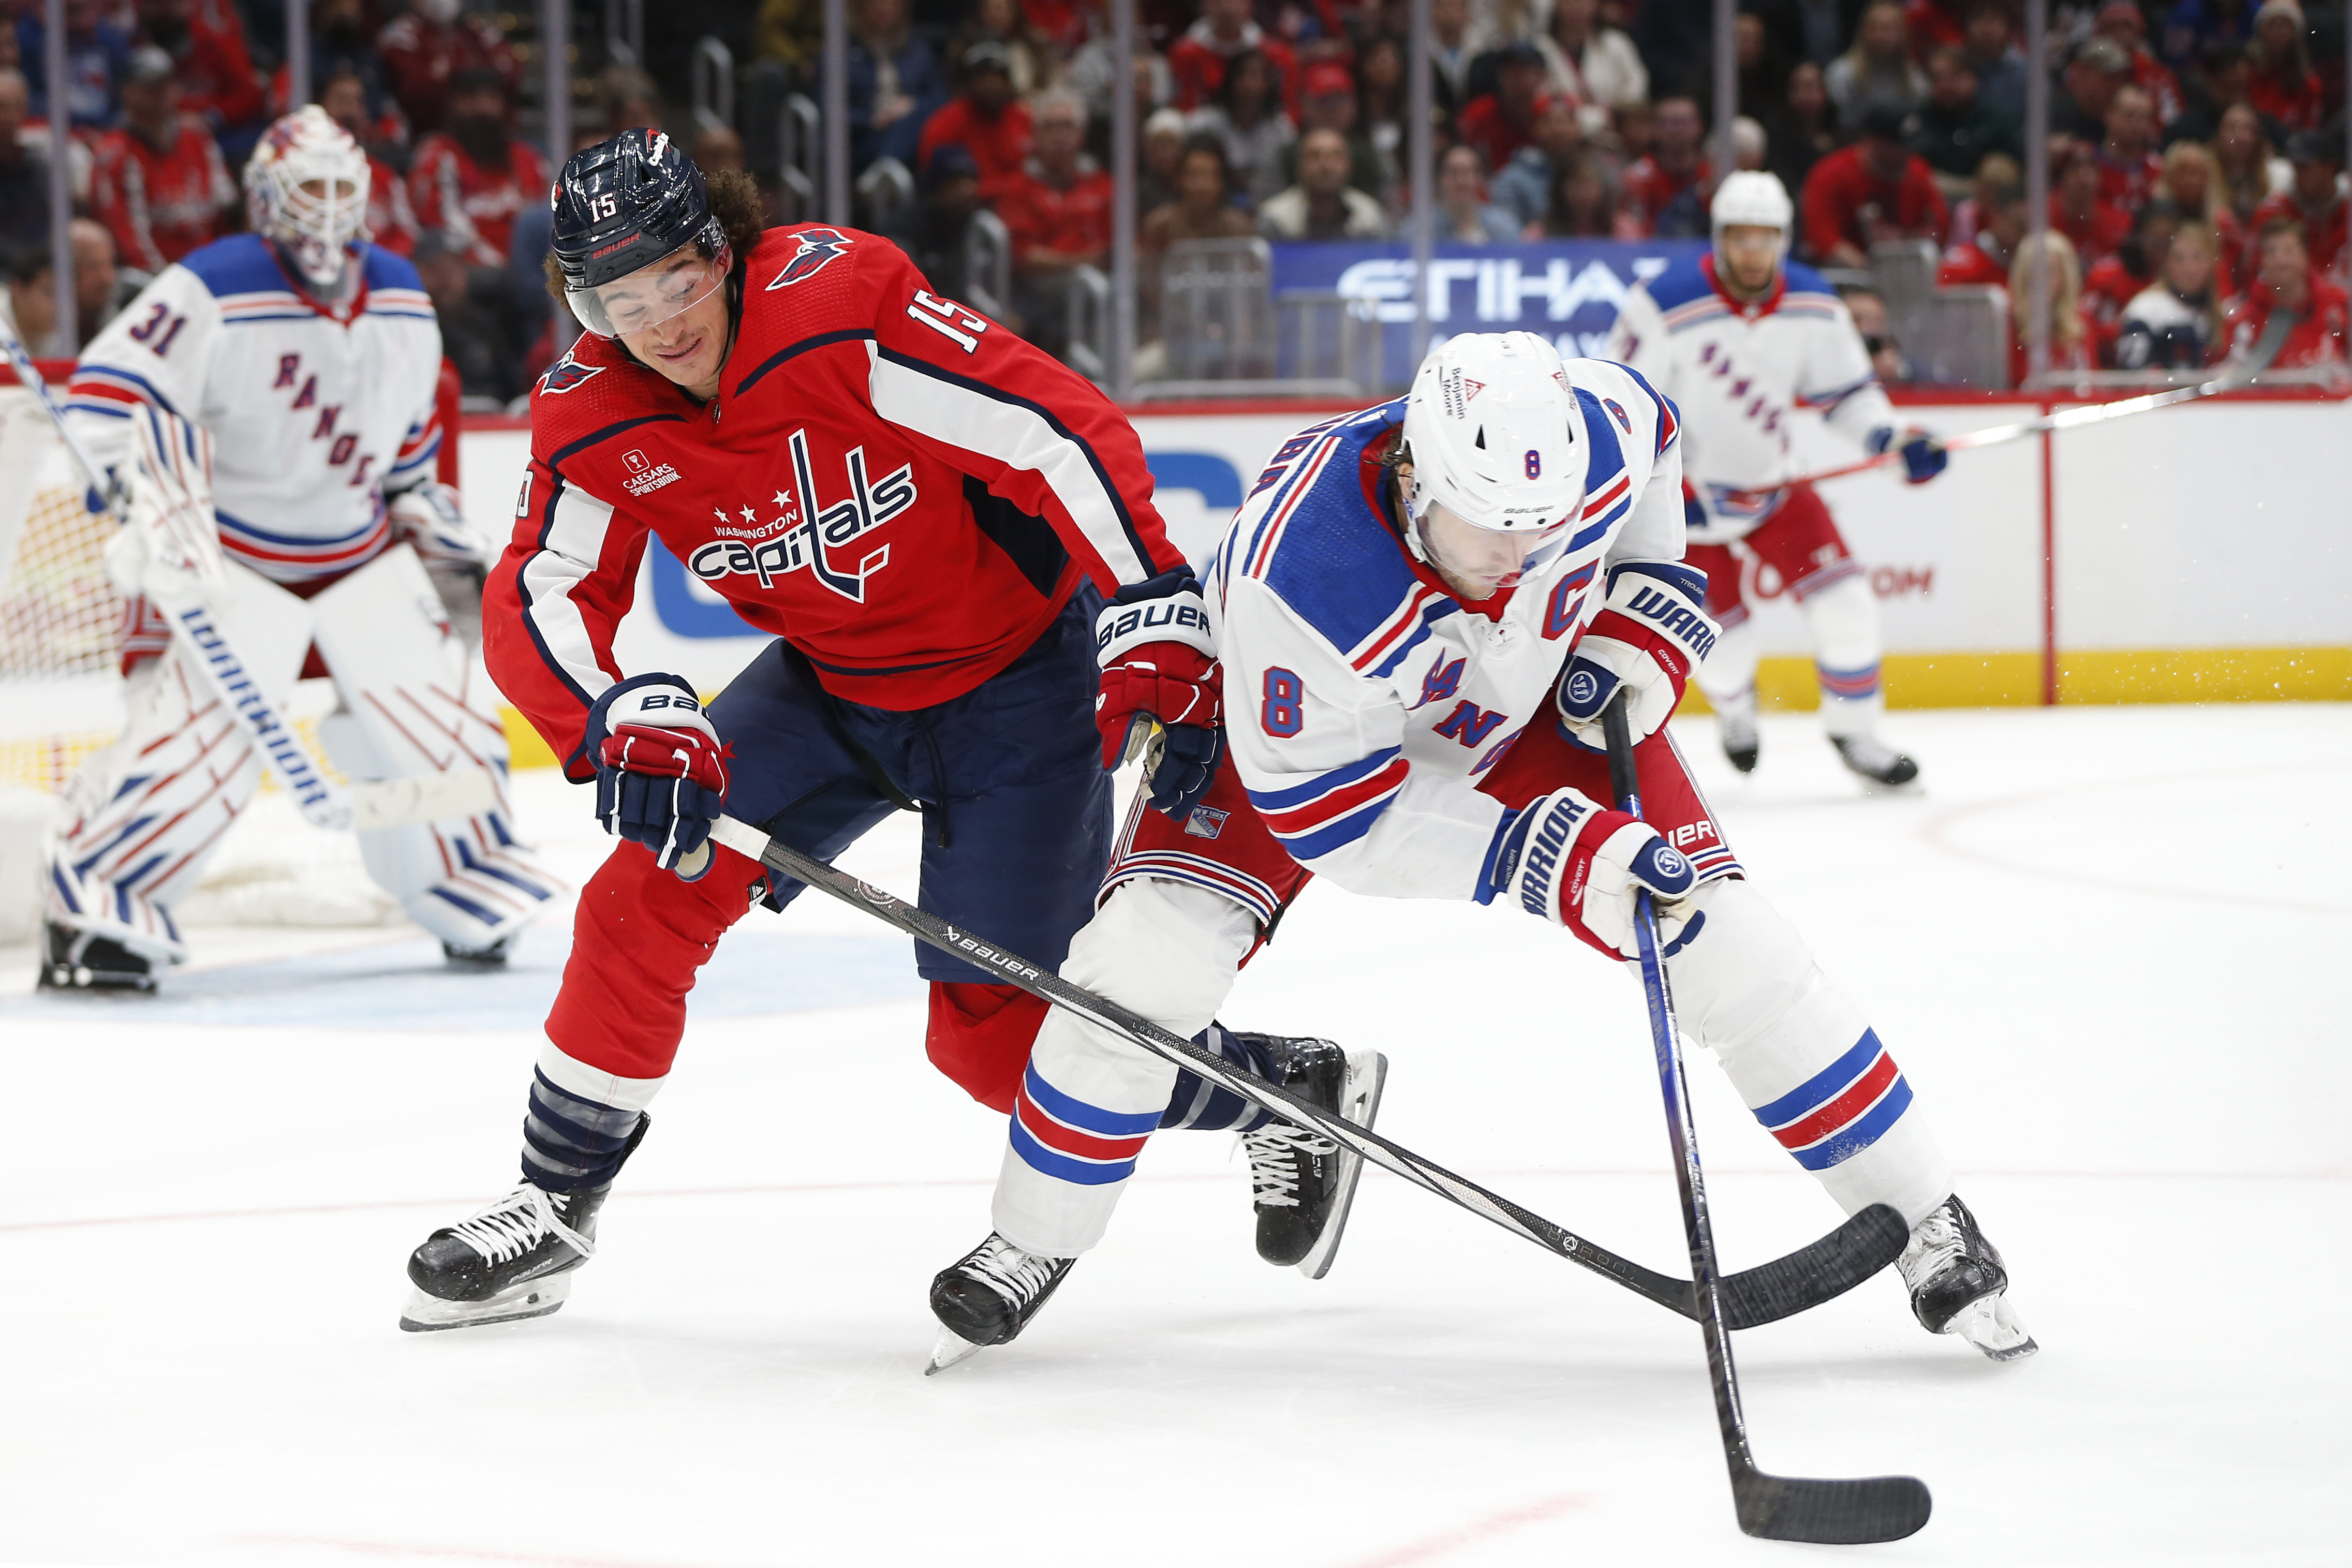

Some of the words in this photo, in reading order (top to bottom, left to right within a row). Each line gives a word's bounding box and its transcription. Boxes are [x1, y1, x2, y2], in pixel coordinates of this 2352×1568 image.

[589, 191, 618, 224] 15
[593, 232, 641, 260] BAUER
[130, 301, 188, 358] 31
[906, 288, 988, 355] 15
[1441, 379, 1455, 417] Moore
[1451, 367, 1467, 420] Benjamin
[629, 470, 682, 497] SPORTSBOOK
[1525, 450, 1540, 480] 8
[714, 509, 798, 539] WASHINGTON
[1503, 505, 1555, 514] BAUER
[1541, 557, 1600, 641] C
[1098, 604, 1211, 650] BAUER
[1657, 648, 1680, 675] COVERT
[179, 608, 329, 806] WARRIOR
[1261, 665, 1303, 739] 8
[1571, 857, 1586, 894] COVERT
[958, 937, 1039, 981] BAUER
[1132, 1022, 1179, 1049] LOADING
